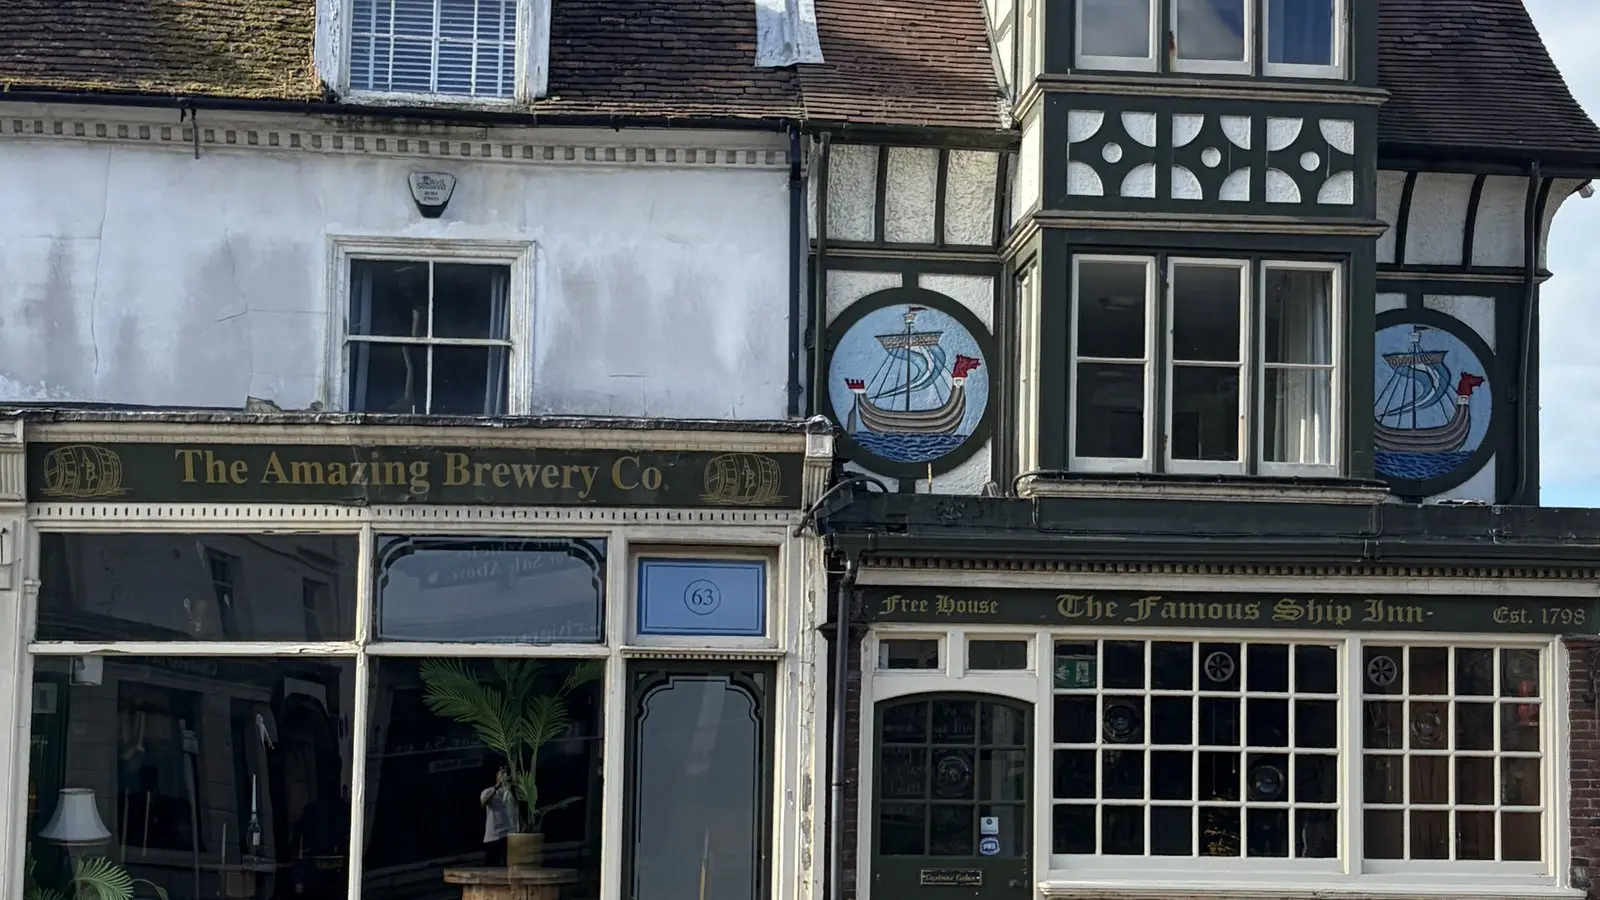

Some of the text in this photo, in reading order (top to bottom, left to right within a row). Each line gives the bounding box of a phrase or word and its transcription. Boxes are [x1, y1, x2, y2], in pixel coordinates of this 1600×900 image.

[175, 449, 669, 498] The Amazing Brewery Co.
[691, 588, 714, 606] 63
[879, 595, 999, 615] Free House
[1056, 594, 1118, 620] The
[1123, 596, 1260, 622] Famous
[1271, 598, 1352, 625] Ship
[1492, 606, 1586, 625] Est. 1798
